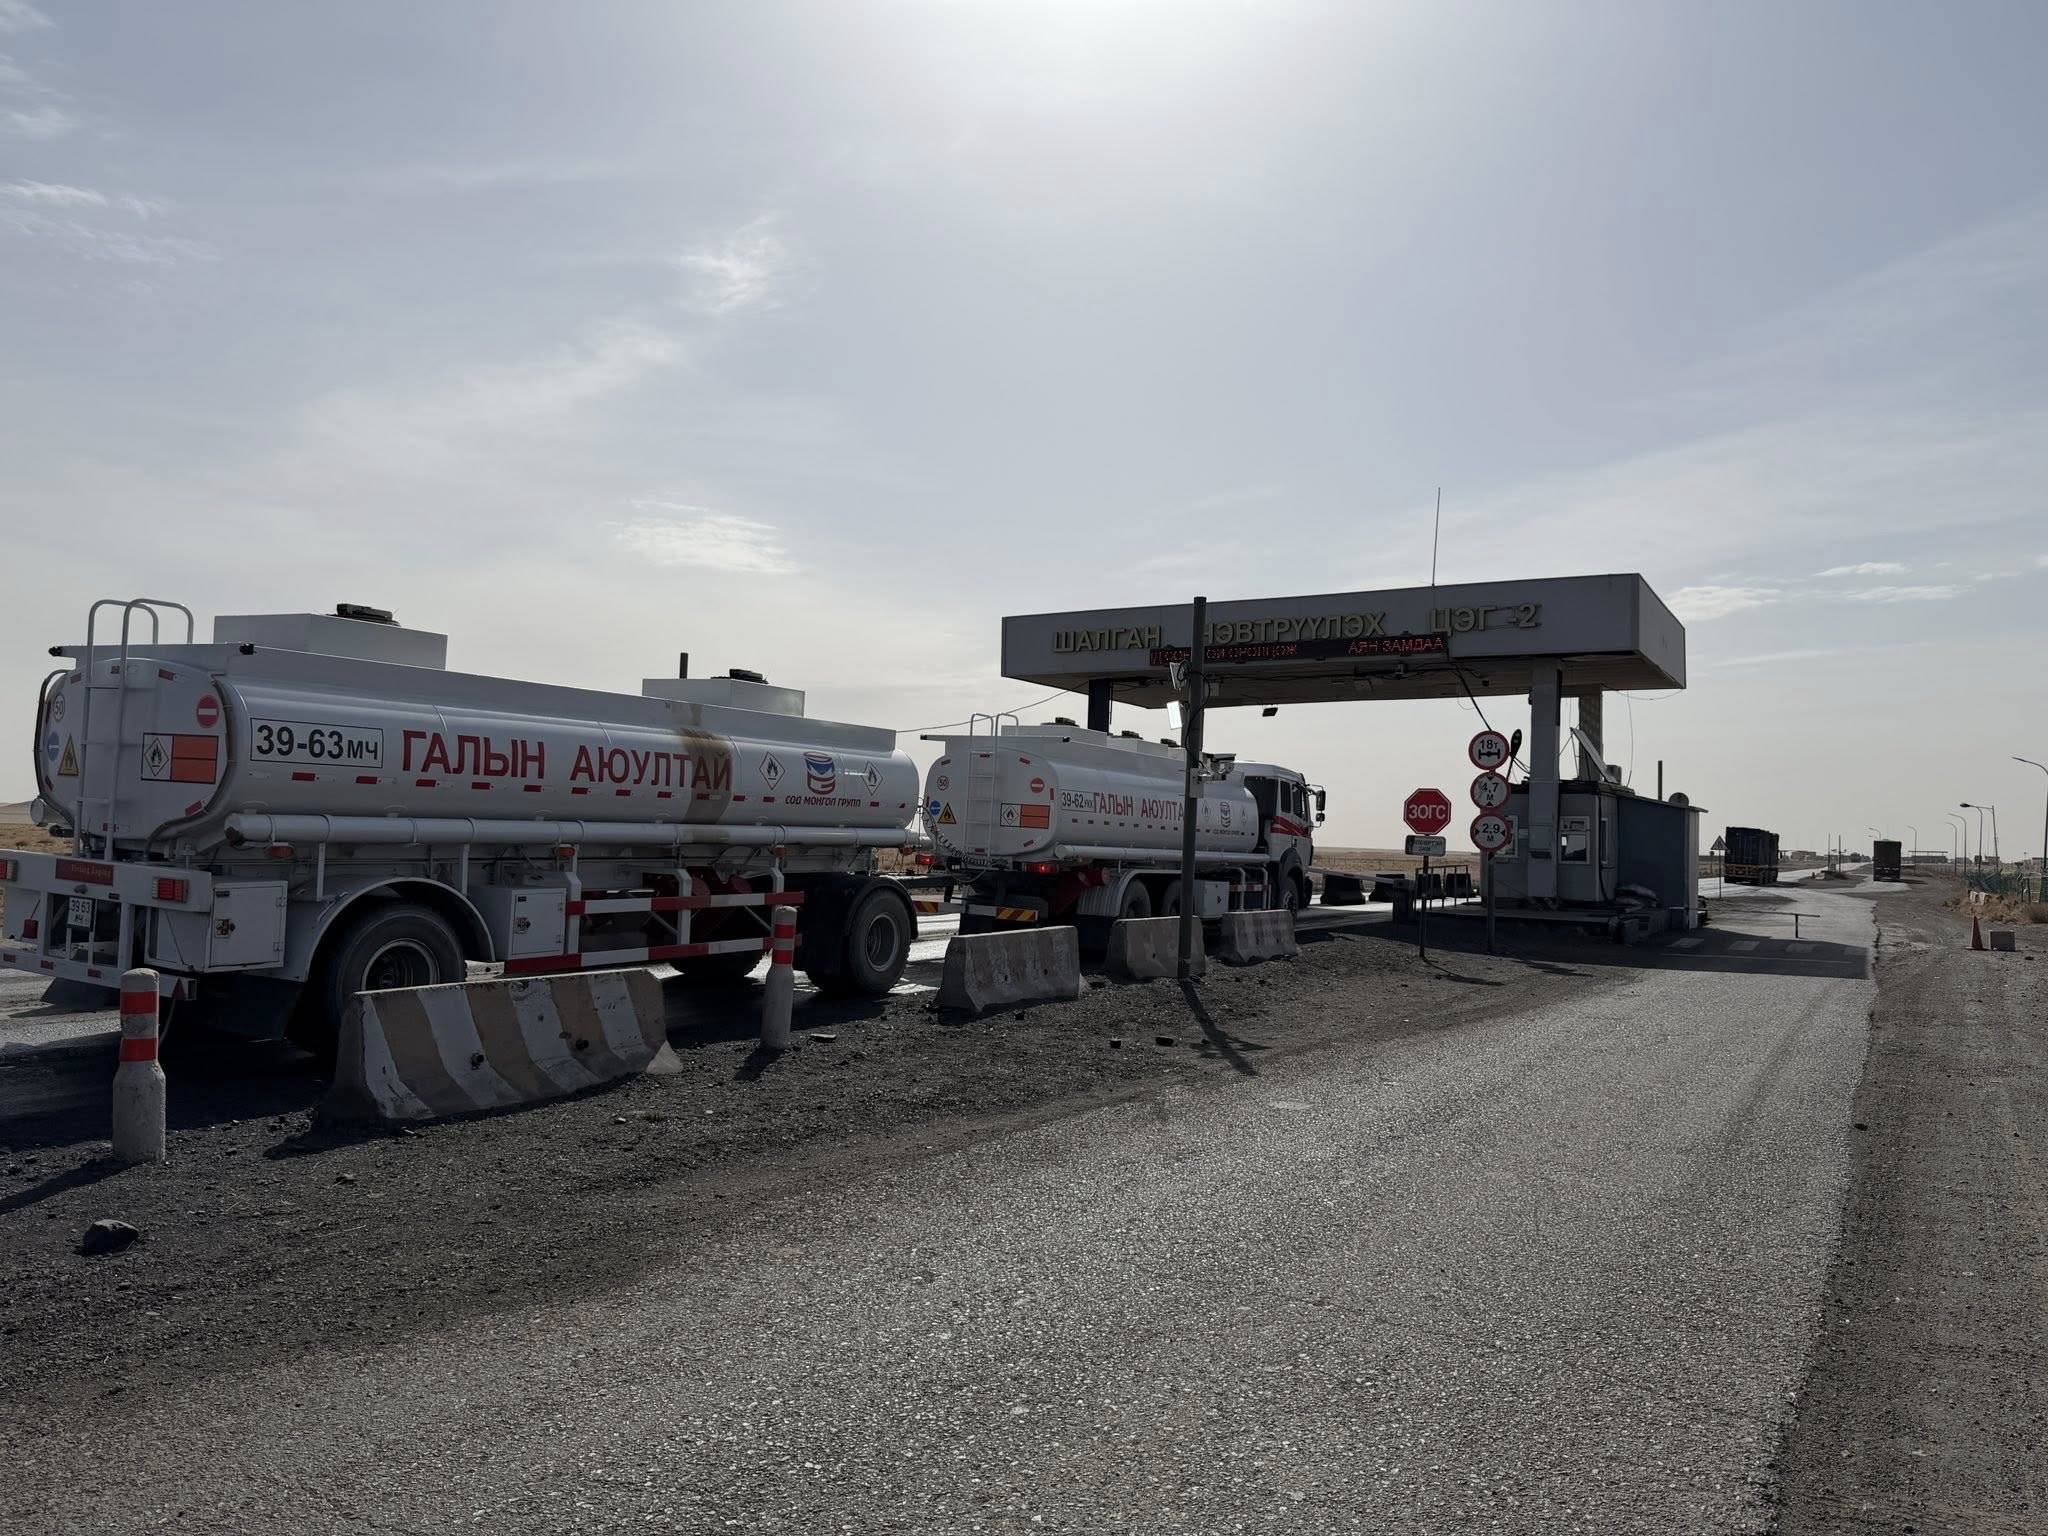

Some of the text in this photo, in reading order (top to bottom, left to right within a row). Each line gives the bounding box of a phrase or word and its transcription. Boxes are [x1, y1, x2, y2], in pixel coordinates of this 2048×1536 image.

[1054, 626, 1161, 653] ШАЛГАН
[1431, 605, 1498, 637] ЦЭГ
[402, 729, 732, 792] ГАЛЫН АЮУЛТАЙ
[939, 777, 948, 788] 50
[803, 796, 837, 807] МОНГОЛ
[837, 798, 861, 808] ГРУПП
[1093, 792, 1185, 821] ГАЛЫН АЮУЛТА
[1408, 804, 1446, 820] ЗОГС
